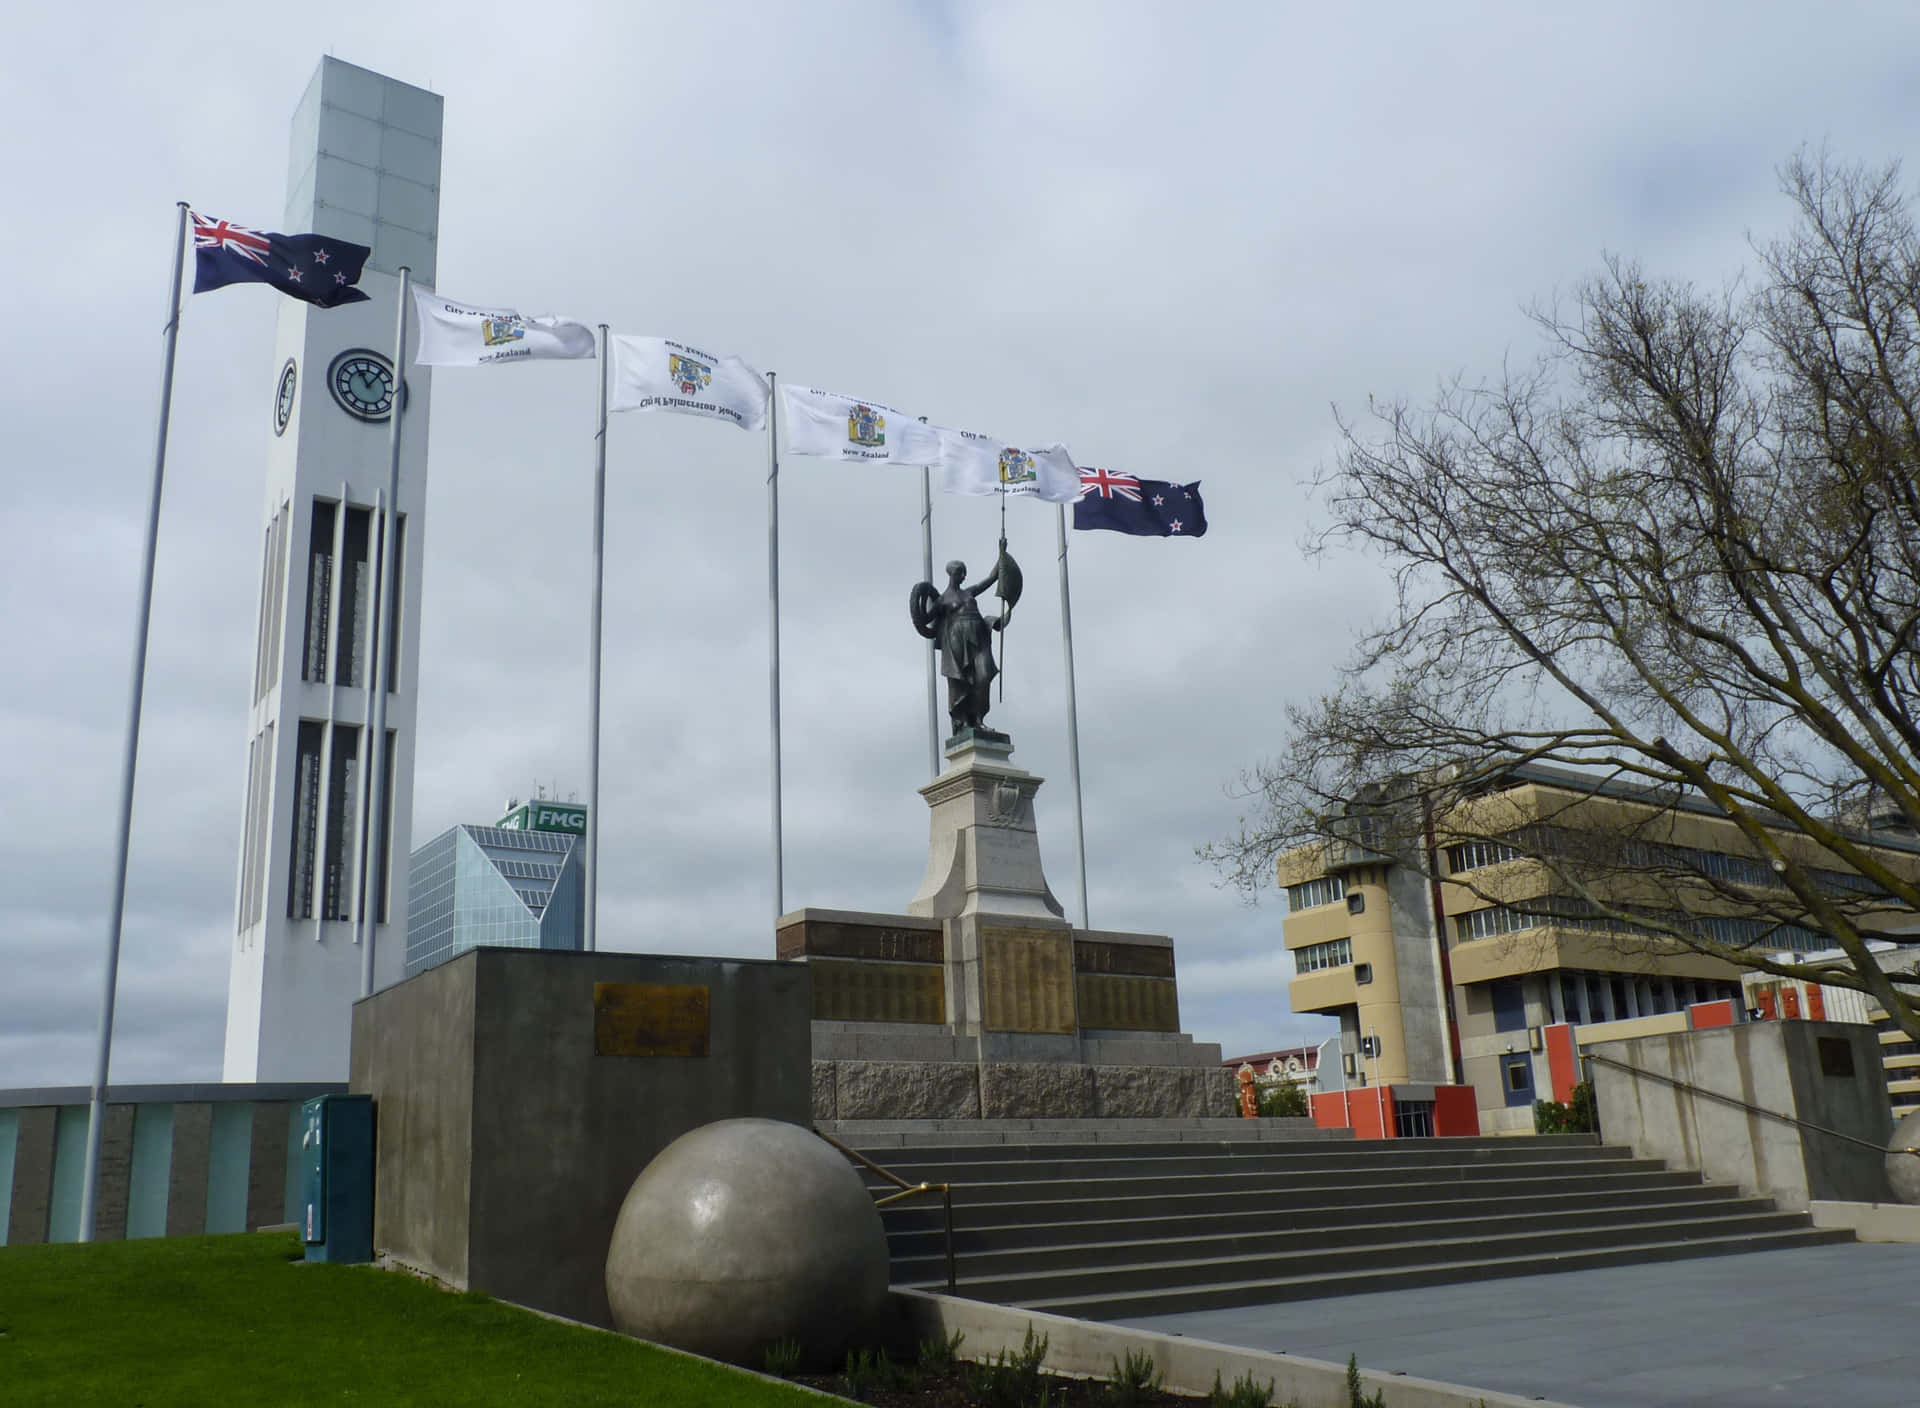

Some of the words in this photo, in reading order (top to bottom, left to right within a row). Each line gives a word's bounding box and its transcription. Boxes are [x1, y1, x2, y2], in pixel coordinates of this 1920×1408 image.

[444, 304, 465, 315] City
[495, 348, 531, 359] Zealand
[960, 431, 977, 440] City
[842, 448, 859, 456] New
[861, 450, 889, 459] Zealand
[1012, 486, 1040, 494] Zealand
[539, 811, 585, 829] FMG
